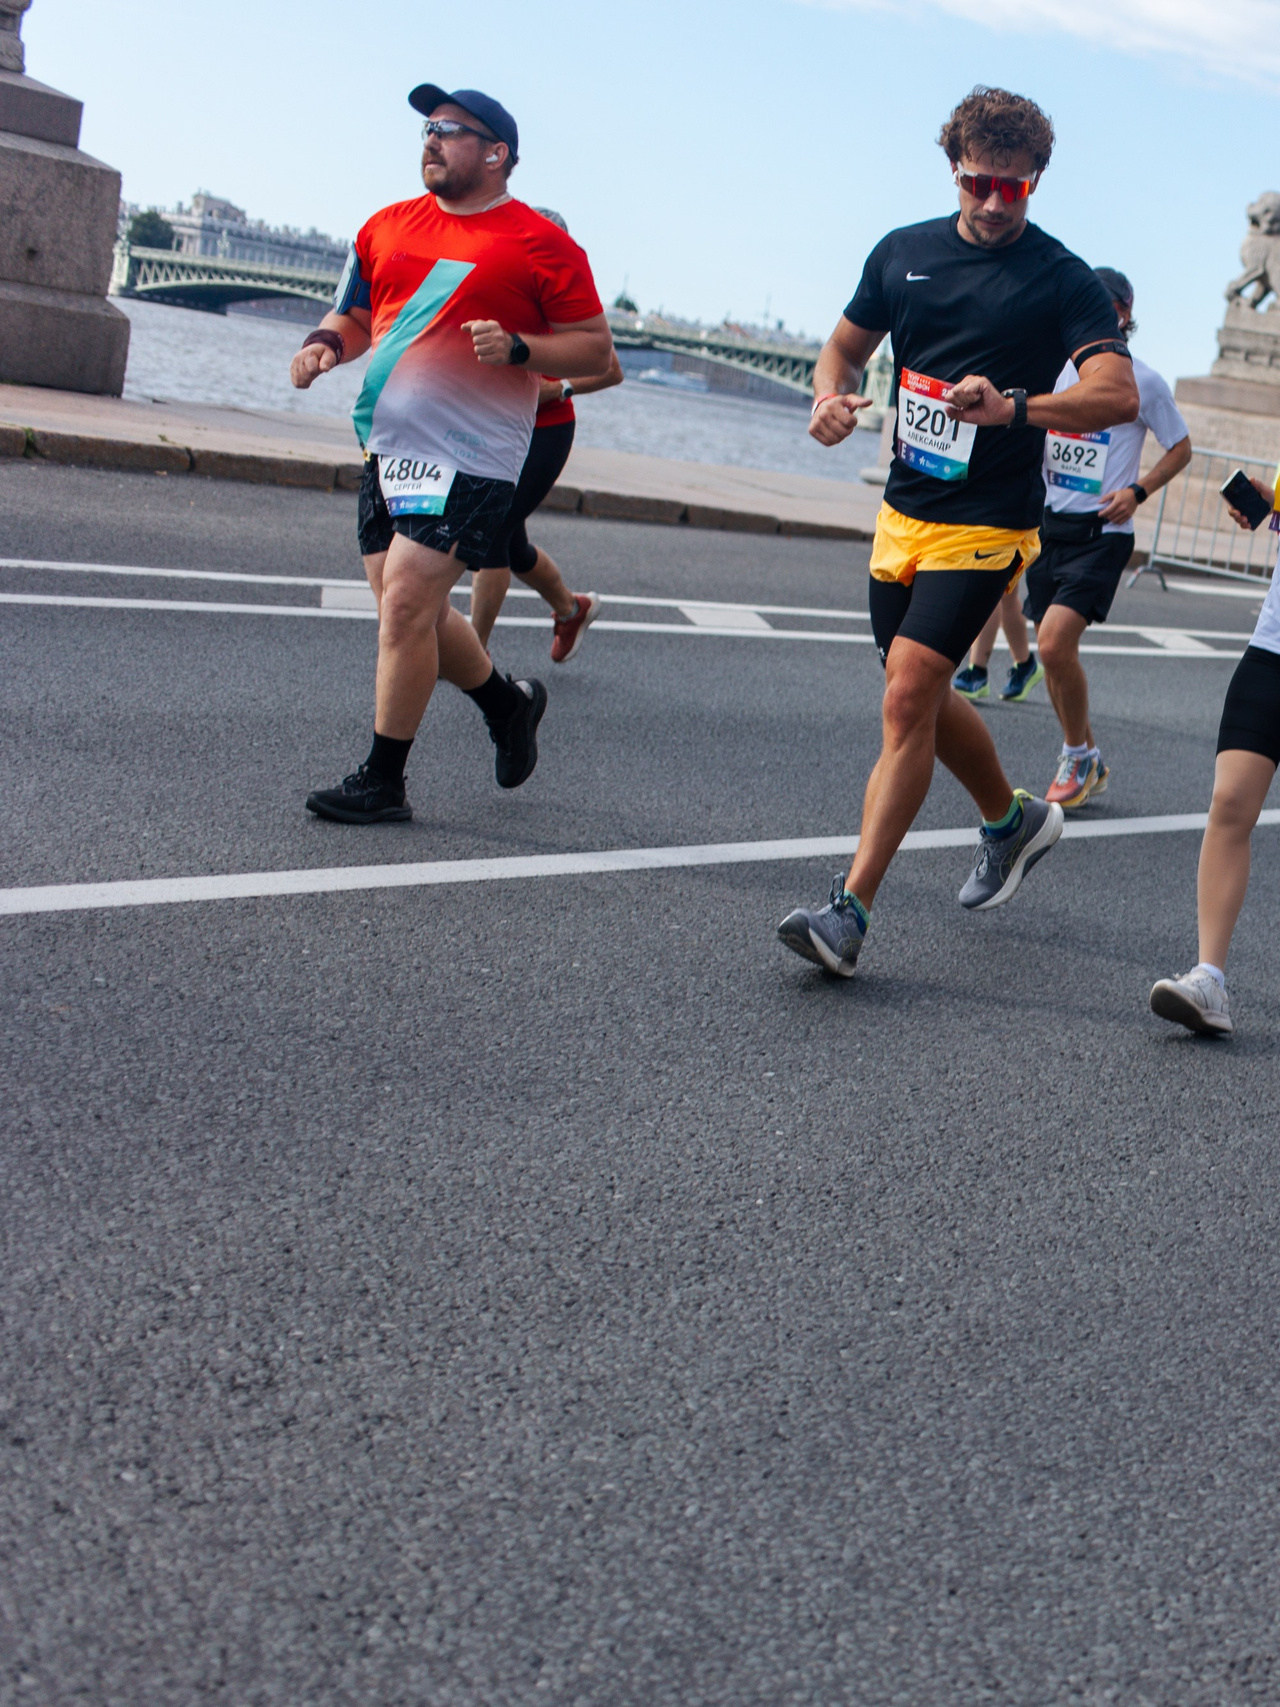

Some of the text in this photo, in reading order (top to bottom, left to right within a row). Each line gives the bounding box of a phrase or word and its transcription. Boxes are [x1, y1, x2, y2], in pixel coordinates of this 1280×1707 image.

[906, 398, 960, 442] 5201
[907, 431, 952, 452] АЛЕКСАНДР
[1052, 442, 1097, 467] 3692
[384, 458, 442, 482] 4804
[394, 482, 422, 492] СЕРГЕЙ
